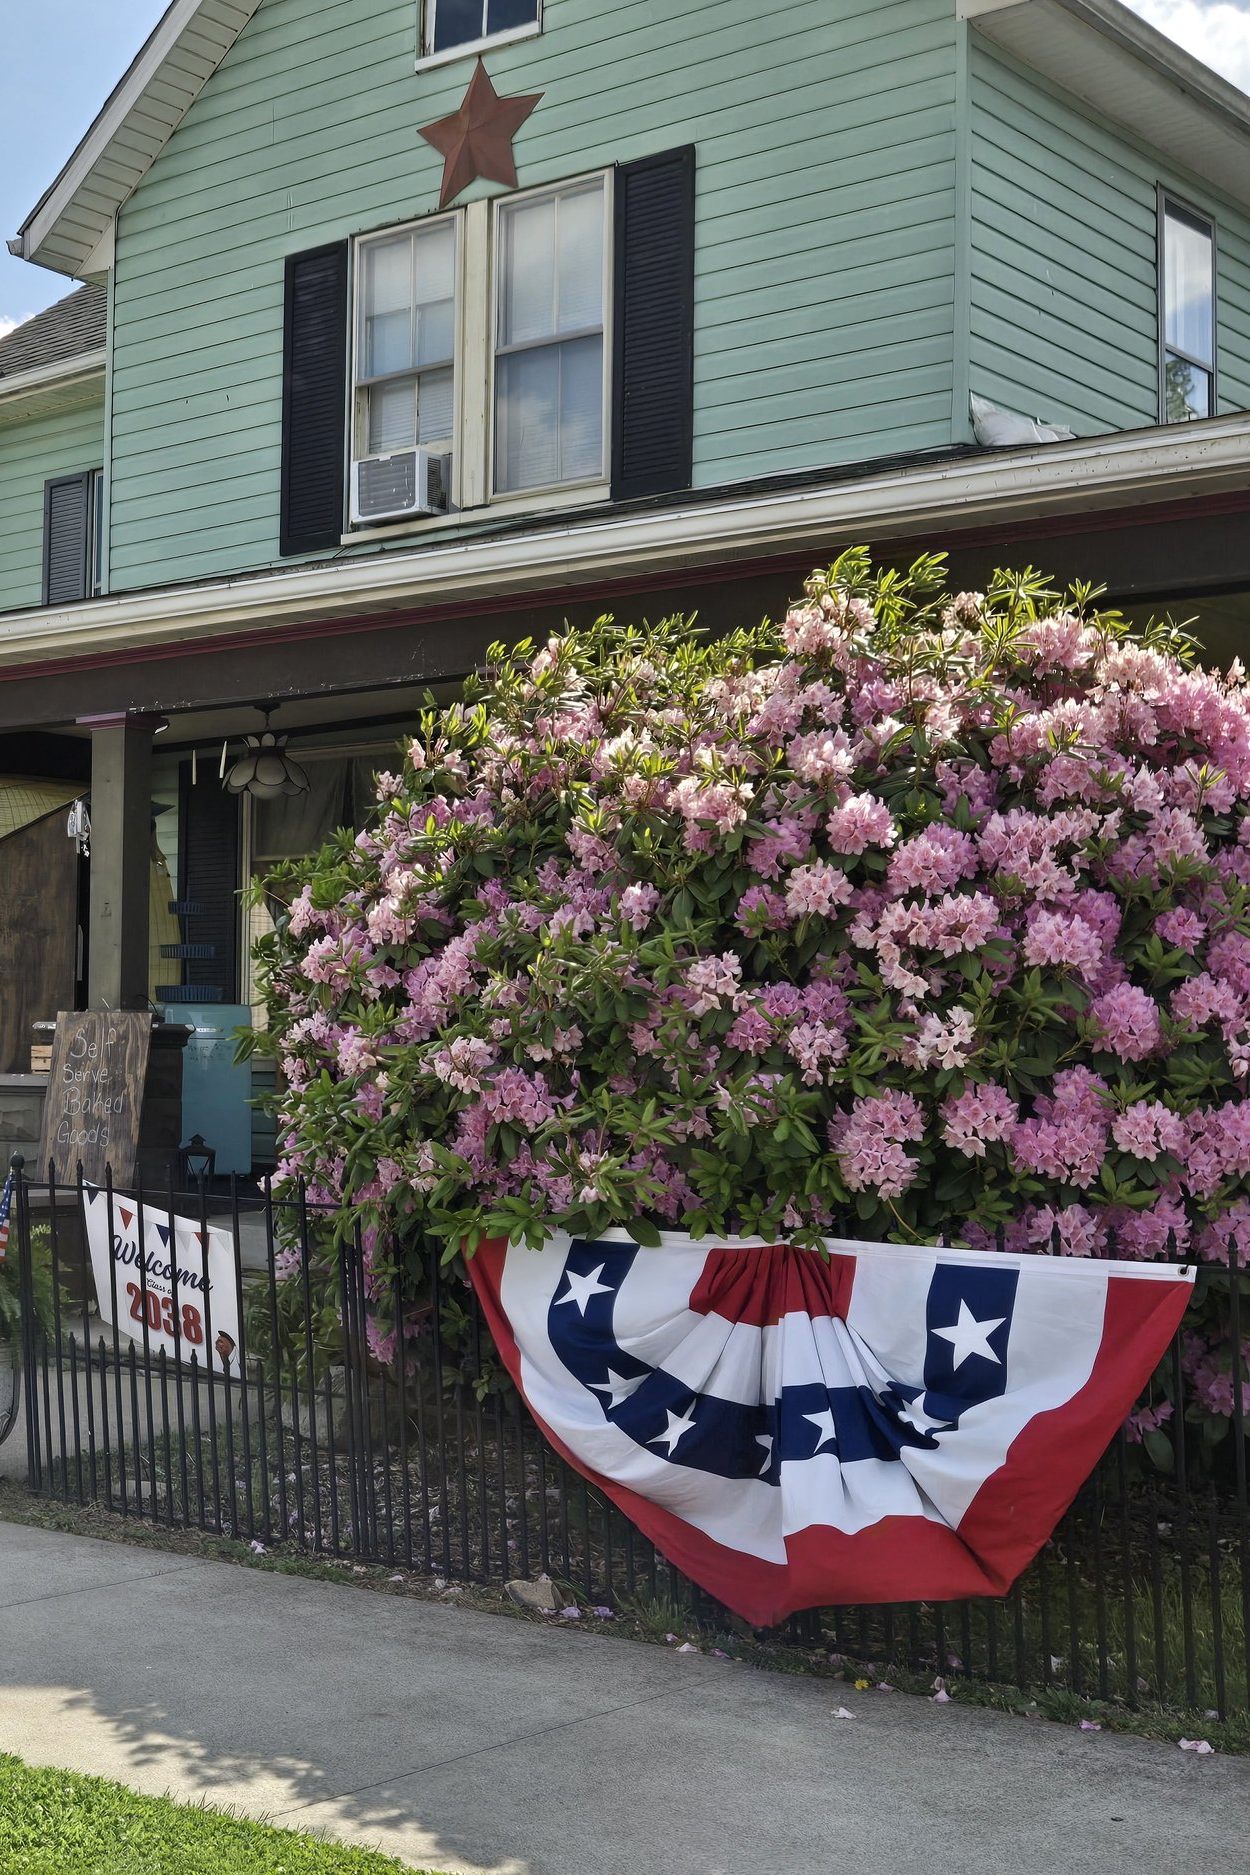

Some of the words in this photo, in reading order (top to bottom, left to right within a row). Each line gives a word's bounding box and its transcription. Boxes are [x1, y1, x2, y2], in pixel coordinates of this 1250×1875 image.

[70, 1027, 117, 1059] Self
[62, 1063, 110, 1084] Serve
[62, 1086, 124, 1116] Baked
[56, 1120, 111, 1148] Goods
[112, 1234, 214, 1293] Welcome
[146, 1277, 166, 1293] Class
[126, 1281, 204, 1345] 2038
